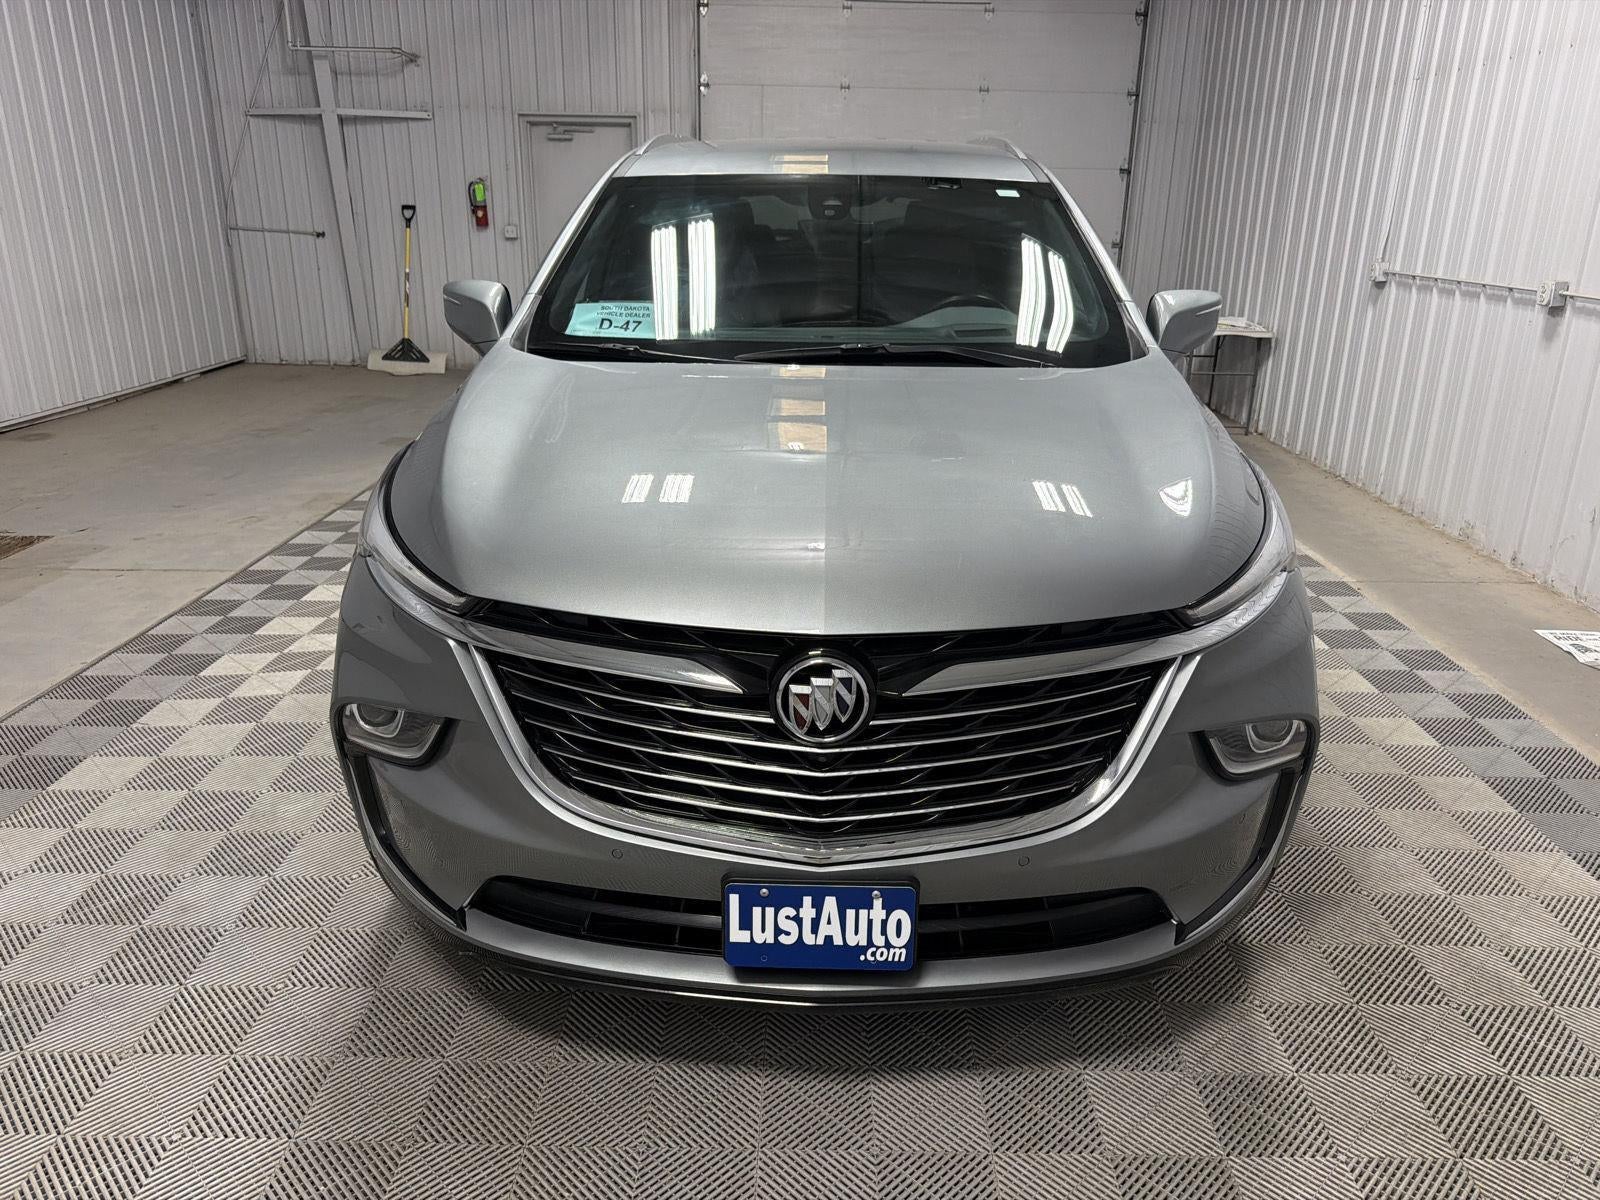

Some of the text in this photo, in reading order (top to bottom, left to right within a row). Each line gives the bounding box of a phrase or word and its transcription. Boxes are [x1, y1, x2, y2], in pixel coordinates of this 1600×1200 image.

[599, 318, 642, 332] D-47
[728, 893, 912, 948] LustAuto
[859, 947, 907, 962] .com
